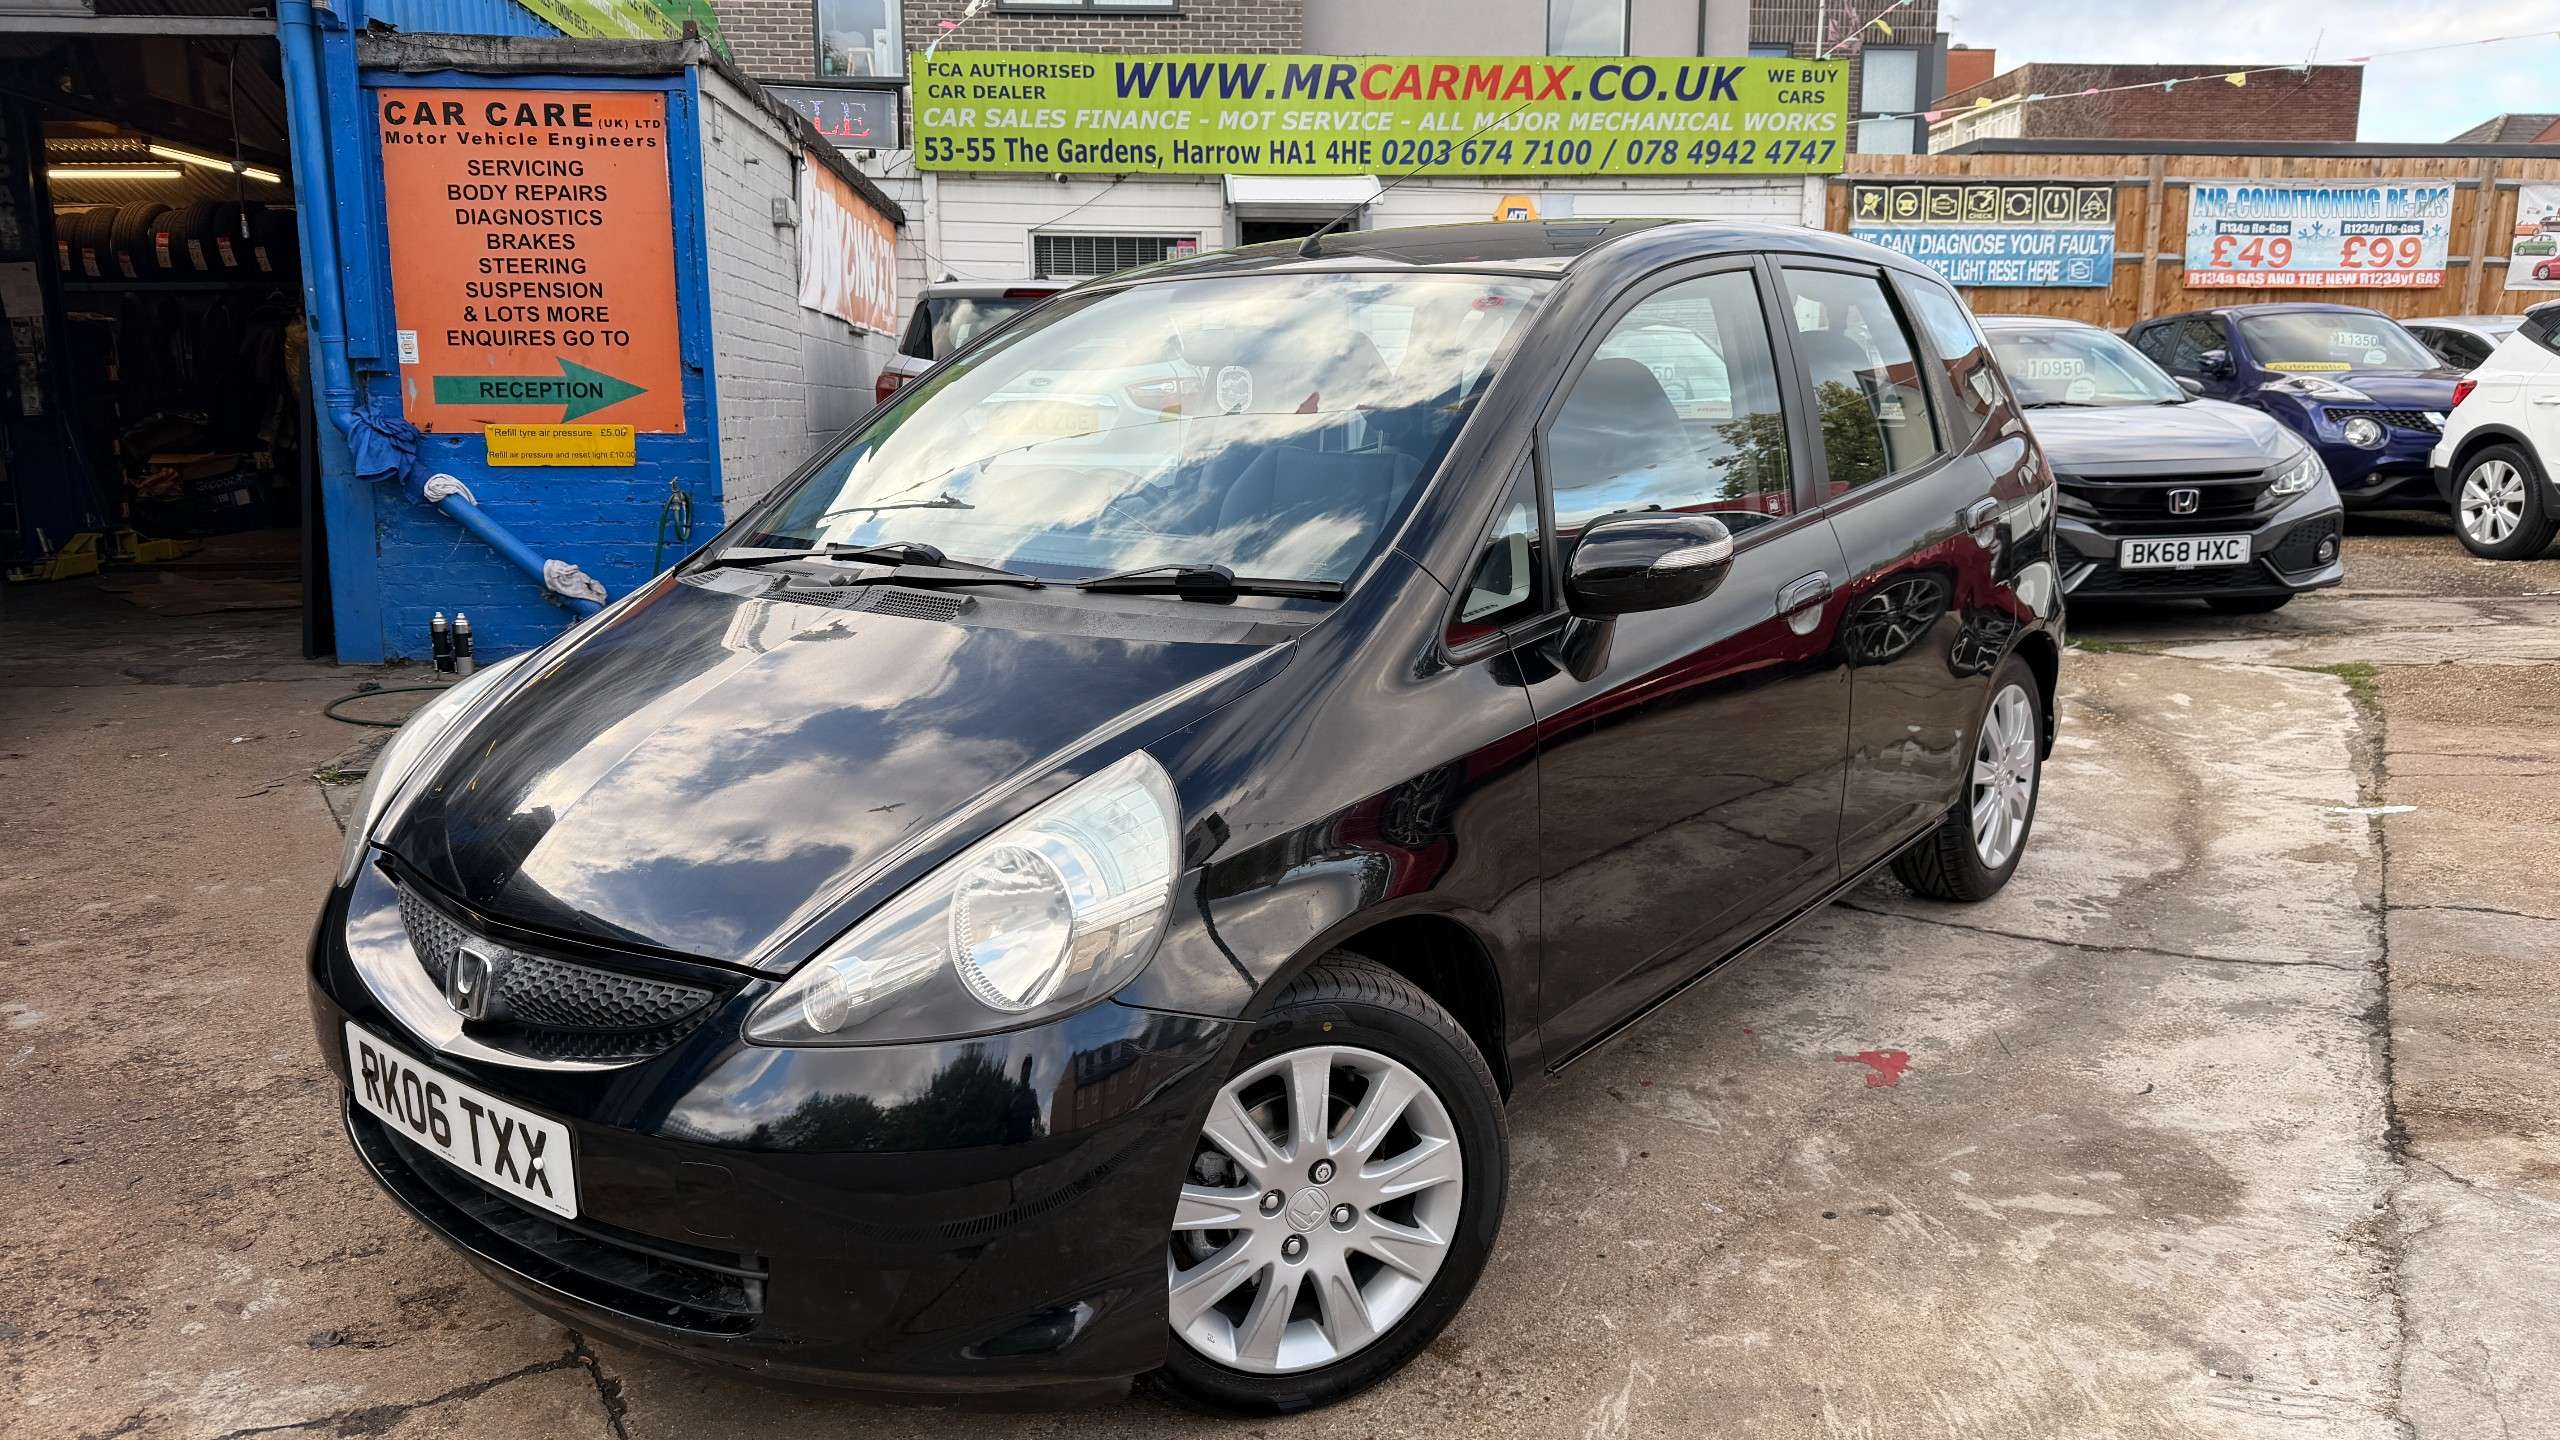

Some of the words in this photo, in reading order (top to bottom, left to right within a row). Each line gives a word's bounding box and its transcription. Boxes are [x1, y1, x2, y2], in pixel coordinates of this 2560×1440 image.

[928, 63, 963, 77] FCA
[970, 64, 1095, 78] AUTHORISED
[1768, 69, 1795, 83] WE
[1802, 70, 1838, 83] BUY
[1115, 63, 1745, 101] WWW.MRCARMAX.CO.UK
[929, 85, 966, 98] CAR
[973, 85, 1046, 99] DEALER
[1778, 90, 1824, 103] CARS
[384, 101, 465, 125] CAR
[486, 102, 592, 127] CARE
[599, 119, 628, 129] (UK)
[636, 120, 660, 128] LTD
[924, 107, 976, 128] CAR
[984, 108, 1067, 128] SALES
[1075, 109, 1191, 129] FINANCE
[1219, 111, 1276, 130] MOT
[1281, 111, 1393, 132] SERVICE
[1418, 112, 1464, 132] ALL
[1474, 111, 1561, 132] MAJOR
[1568, 112, 1732, 132] MECHANICAL
[1744, 112, 1836, 132] WORKS
[385, 131, 446, 144] Motor
[457, 132, 537, 145] Vehicle
[549, 133, 656, 149] Engineers
[925, 137, 995, 162] 53-55
[1004, 137, 1048, 162] The
[1057, 138, 1163, 169] Gardens,
[1174, 140, 1260, 164] Harrow
[1270, 141, 1316, 164] HA1
[1326, 141, 1371, 164] 4HE
[1381, 139, 1451, 165] 0203
[1460, 139, 1513, 165] 674
[1523, 140, 1591, 165] 7100
[1599, 139, 1617, 170] /
[1627, 140, 1678, 165] 078
[1687, 140, 1756, 164] 4942
[1765, 140, 1835, 164] 4747
[468, 160, 583, 176] SERVICING
[448, 185, 507, 200] BODY
[516, 185, 607, 201] REPAIRS
[2193, 188, 2380, 218] AIR-CONDITIONING
[2386, 188, 2449, 218] RE-GAS
[456, 209, 602, 225] DIAGNOSTICS
[2220, 223, 2250, 233] R134a
[2252, 224, 2289, 233] Re-Gas
[2344, 224, 2383, 234] R1234yf
[2385, 224, 2421, 233] Re-Gas
[487, 234, 575, 250] BRAKES
[1881, 234, 1917, 254] CAN
[1920, 234, 2007, 255] DIAGNOSE
[2010, 234, 2056, 255] YOUR
[2058, 234, 2109, 255] FAULT
[2210, 235, 2293, 268] £49
[2341, 236, 2422, 268] £99
[479, 258, 586, 274] STEERING
[1951, 260, 1986, 281] LIGHT
[1988, 260, 2026, 282] RESET
[2027, 260, 2060, 281] HERE
[2189, 272, 2234, 285] R134a
[2236, 272, 2266, 285] GAS
[2267, 272, 2296, 285] AND
[2298, 272, 2323, 285] THE
[2325, 272, 2357, 285] NEW
[2359, 272, 2414, 286] R1234yf
[2416, 272, 2441, 285] GAS
[466, 282, 602, 298] SUSPENSION
[464, 306, 478, 322] &
[485, 306, 539, 322] LOTS
[547, 306, 609, 322] MORE
[447, 330, 555, 346] ENQUIRES
[563, 330, 594, 346] GO
[601, 331, 629, 346] TO
[480, 382, 603, 398] RECEPTION
[494, 428, 517, 437] Refill
[519, 429, 536, 439] tyre
[538, 429, 550, 437] air
[553, 429, 593, 439] pressure
[489, 451, 508, 459] Refill
[520, 452, 553, 461] pressure
[555, 451, 569, 459] and
[592, 451, 608, 461] light
[2131, 542, 2190, 564] BK68
[2196, 540, 2239, 561] HXC
[358, 1040, 452, 1149] RK06
[459, 1096, 554, 1199] TXX
